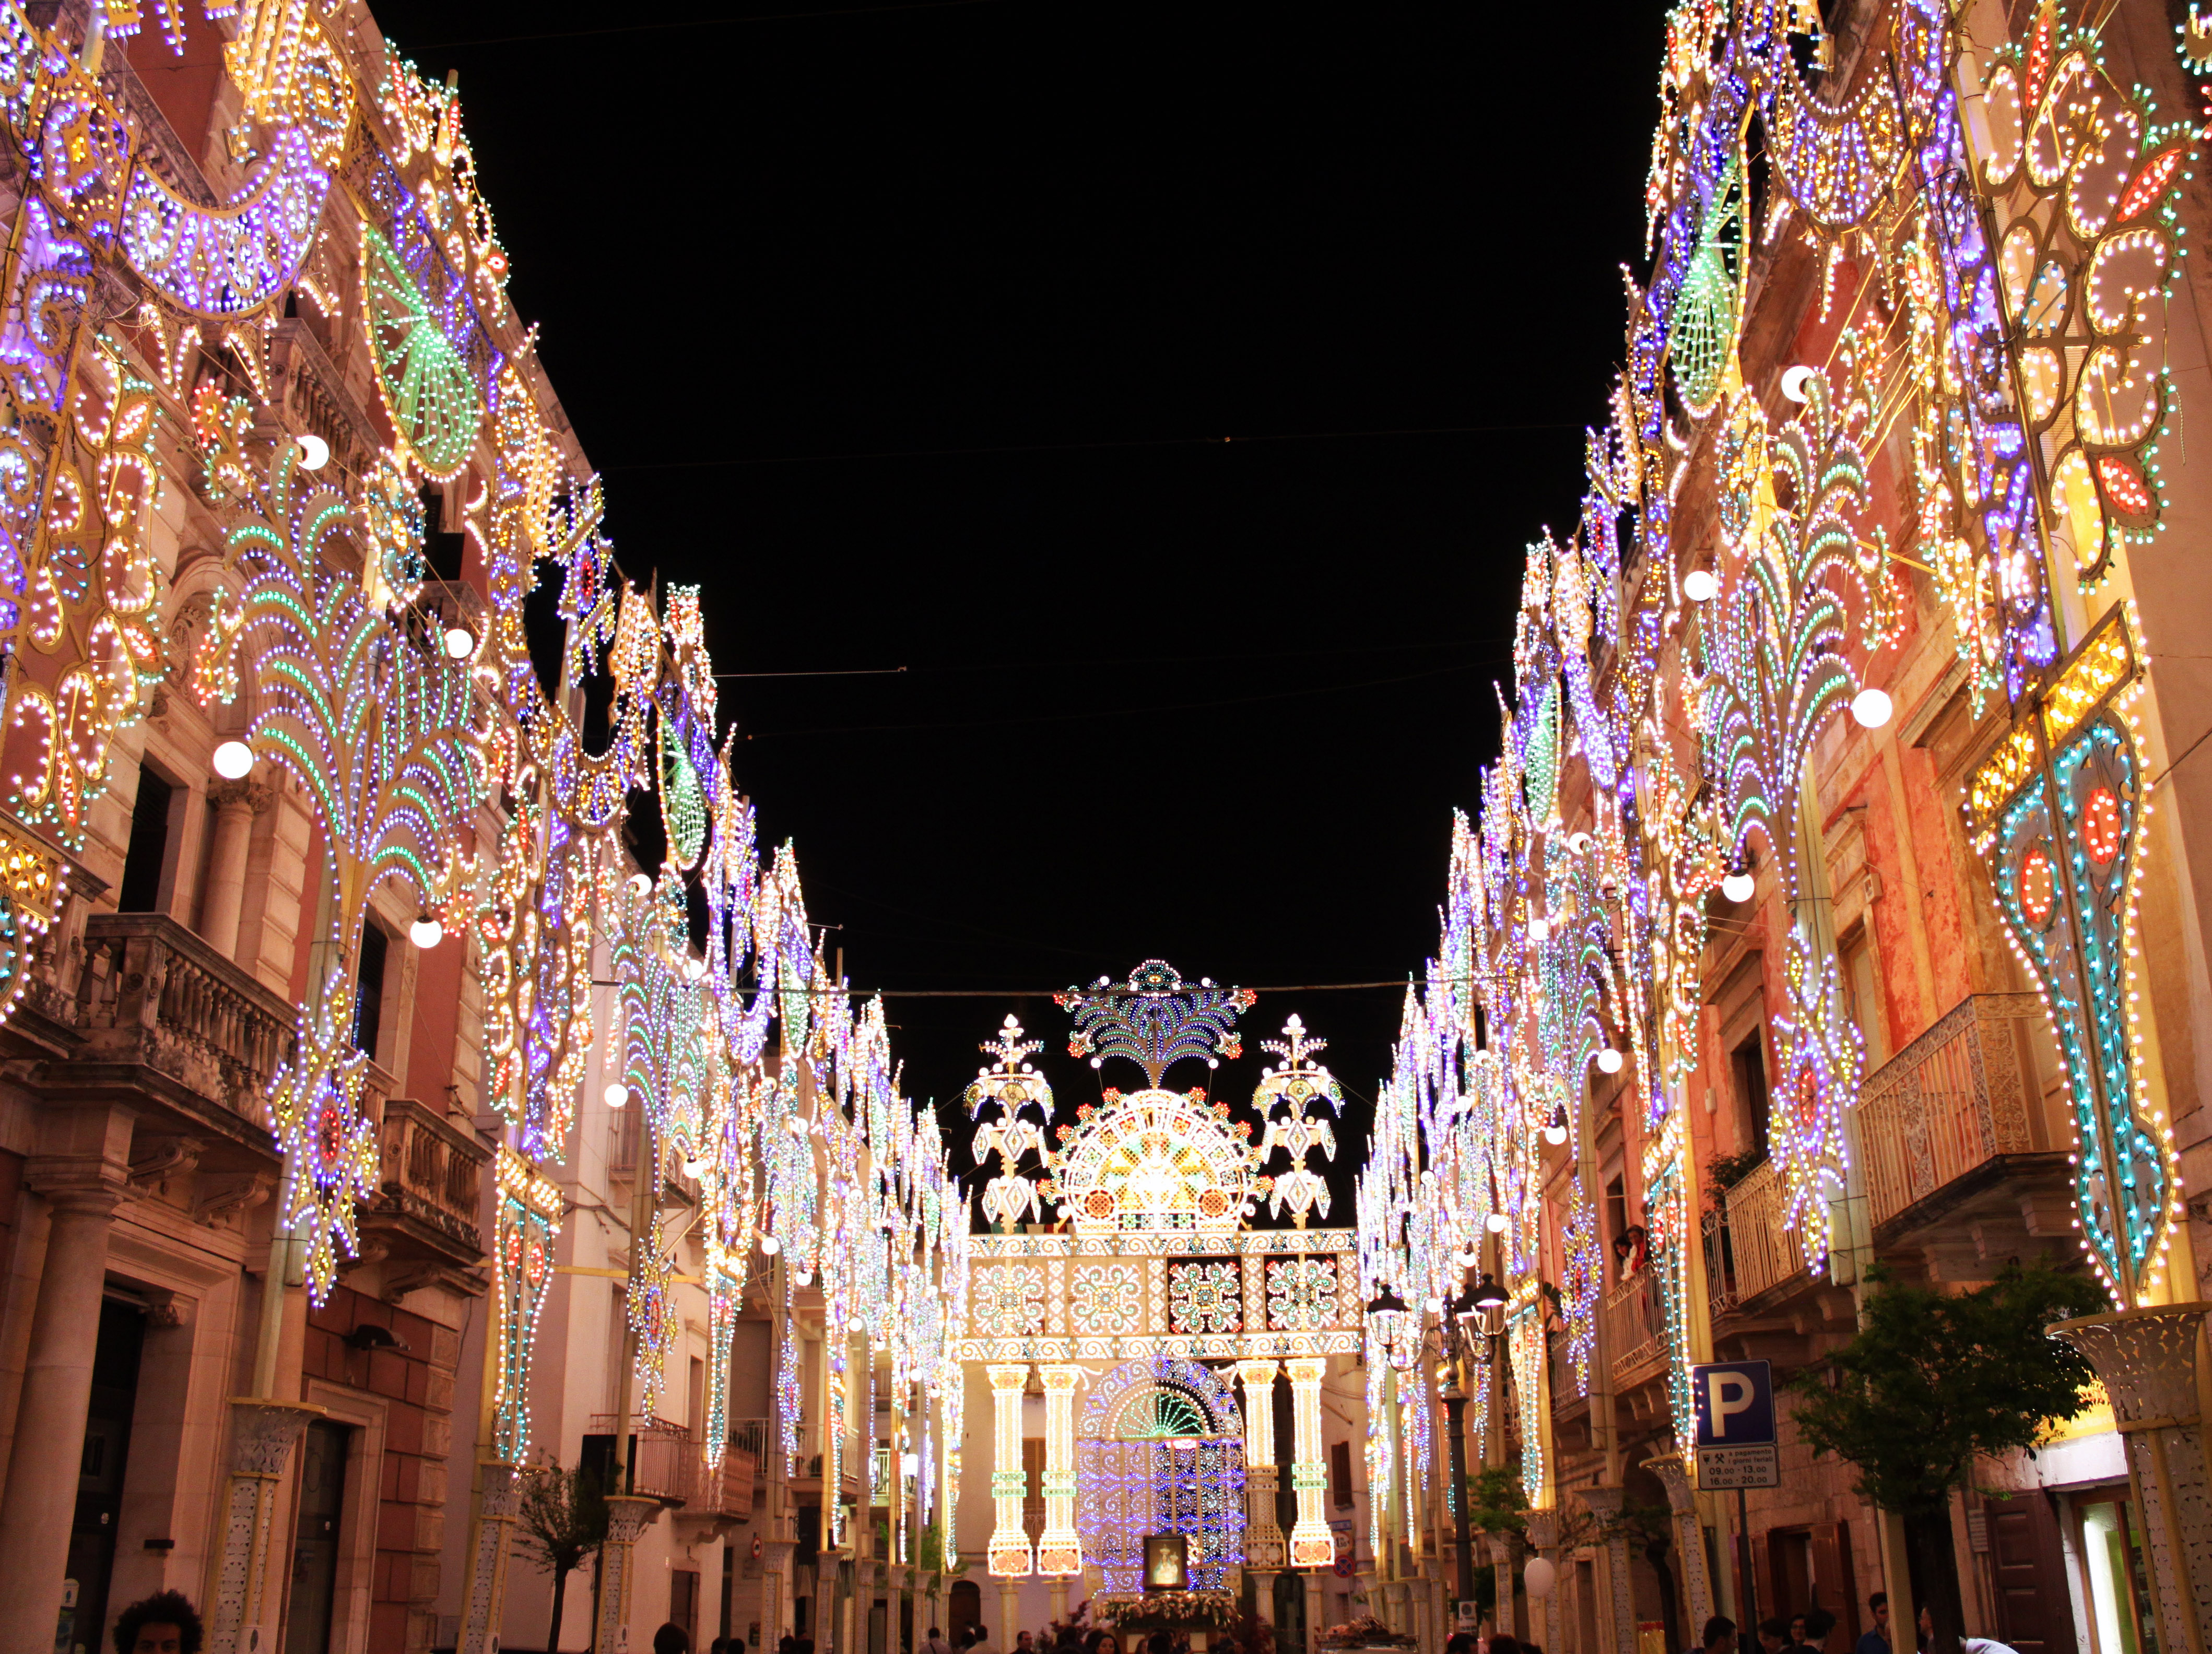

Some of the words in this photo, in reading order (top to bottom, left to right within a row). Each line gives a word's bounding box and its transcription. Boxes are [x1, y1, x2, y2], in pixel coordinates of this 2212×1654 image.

[1708, 1372, 1755, 1437] P
[1743, 1465, 1767, 1473] 13.00
[1710, 1477, 1733, 1485] 16.00
[1742, 1475, 1767, 1484] 20.00
